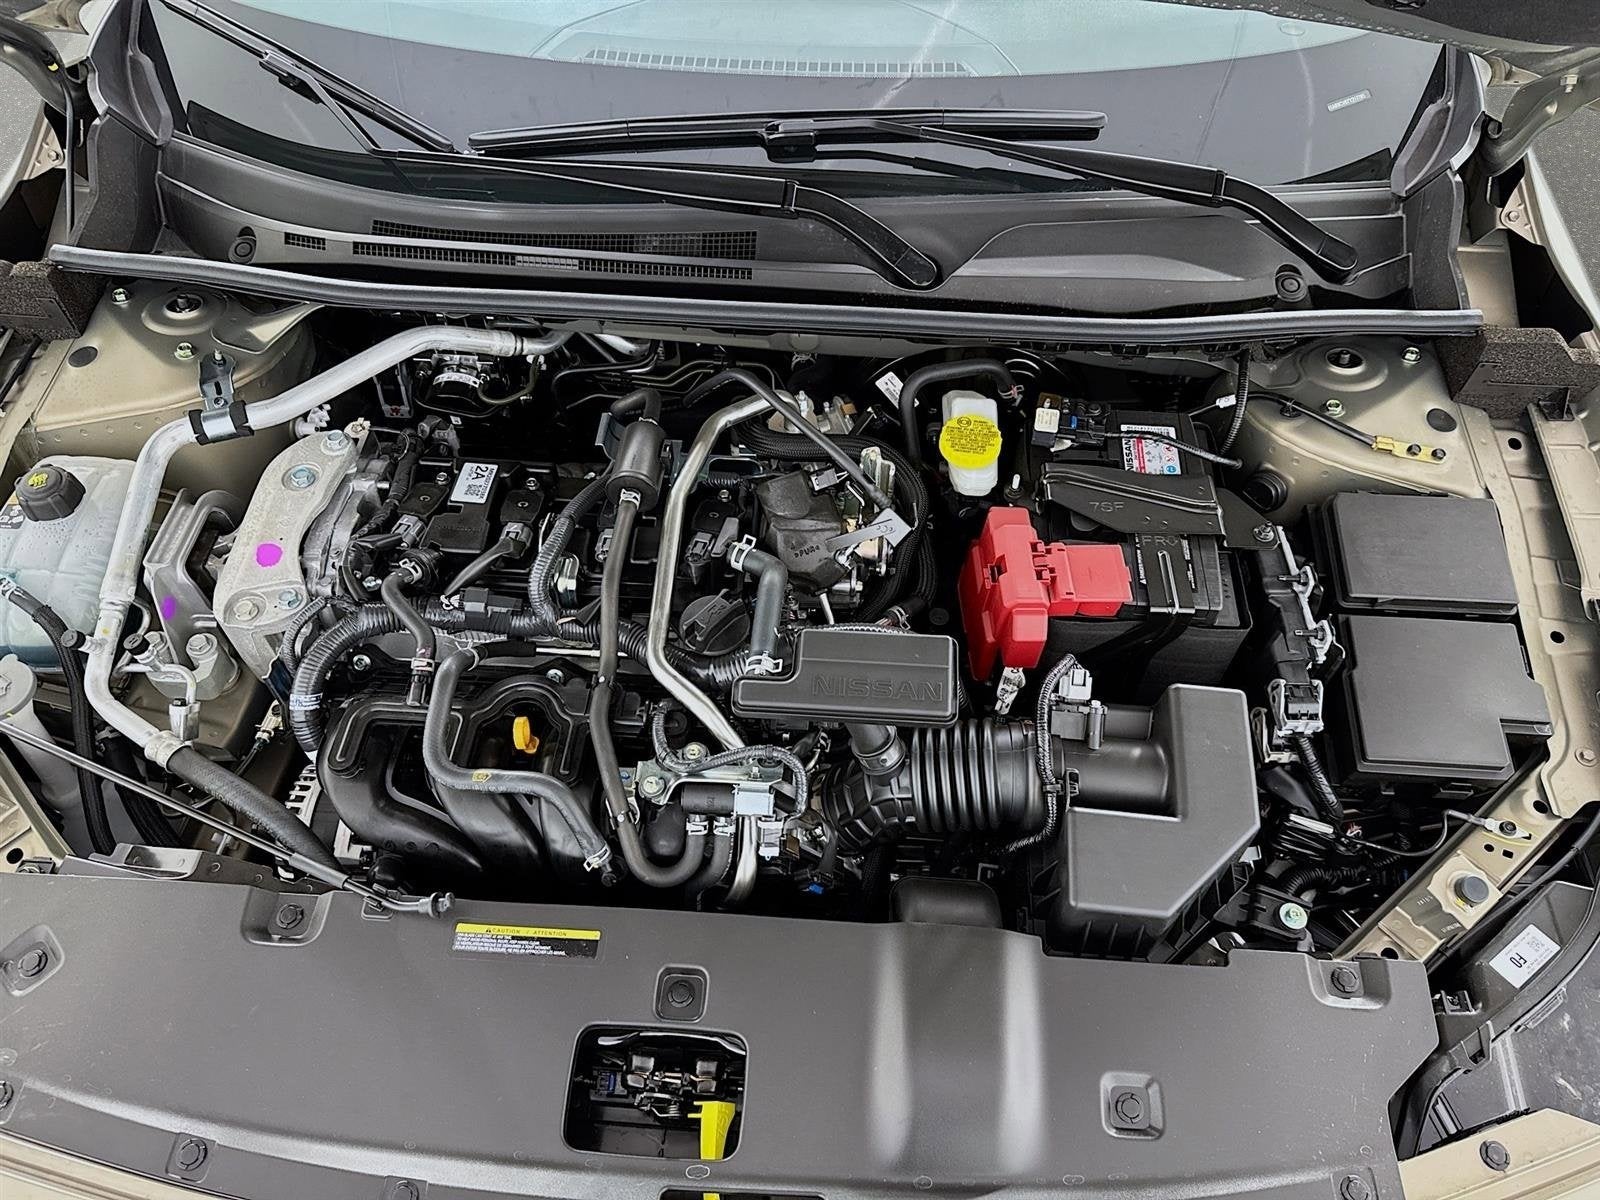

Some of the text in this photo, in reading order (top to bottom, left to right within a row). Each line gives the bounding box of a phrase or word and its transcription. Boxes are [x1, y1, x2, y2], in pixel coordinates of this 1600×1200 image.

[471, 465, 489, 480] 2A
[813, 673, 943, 701] NISSAN
[492, 927, 521, 935] CAUTION
